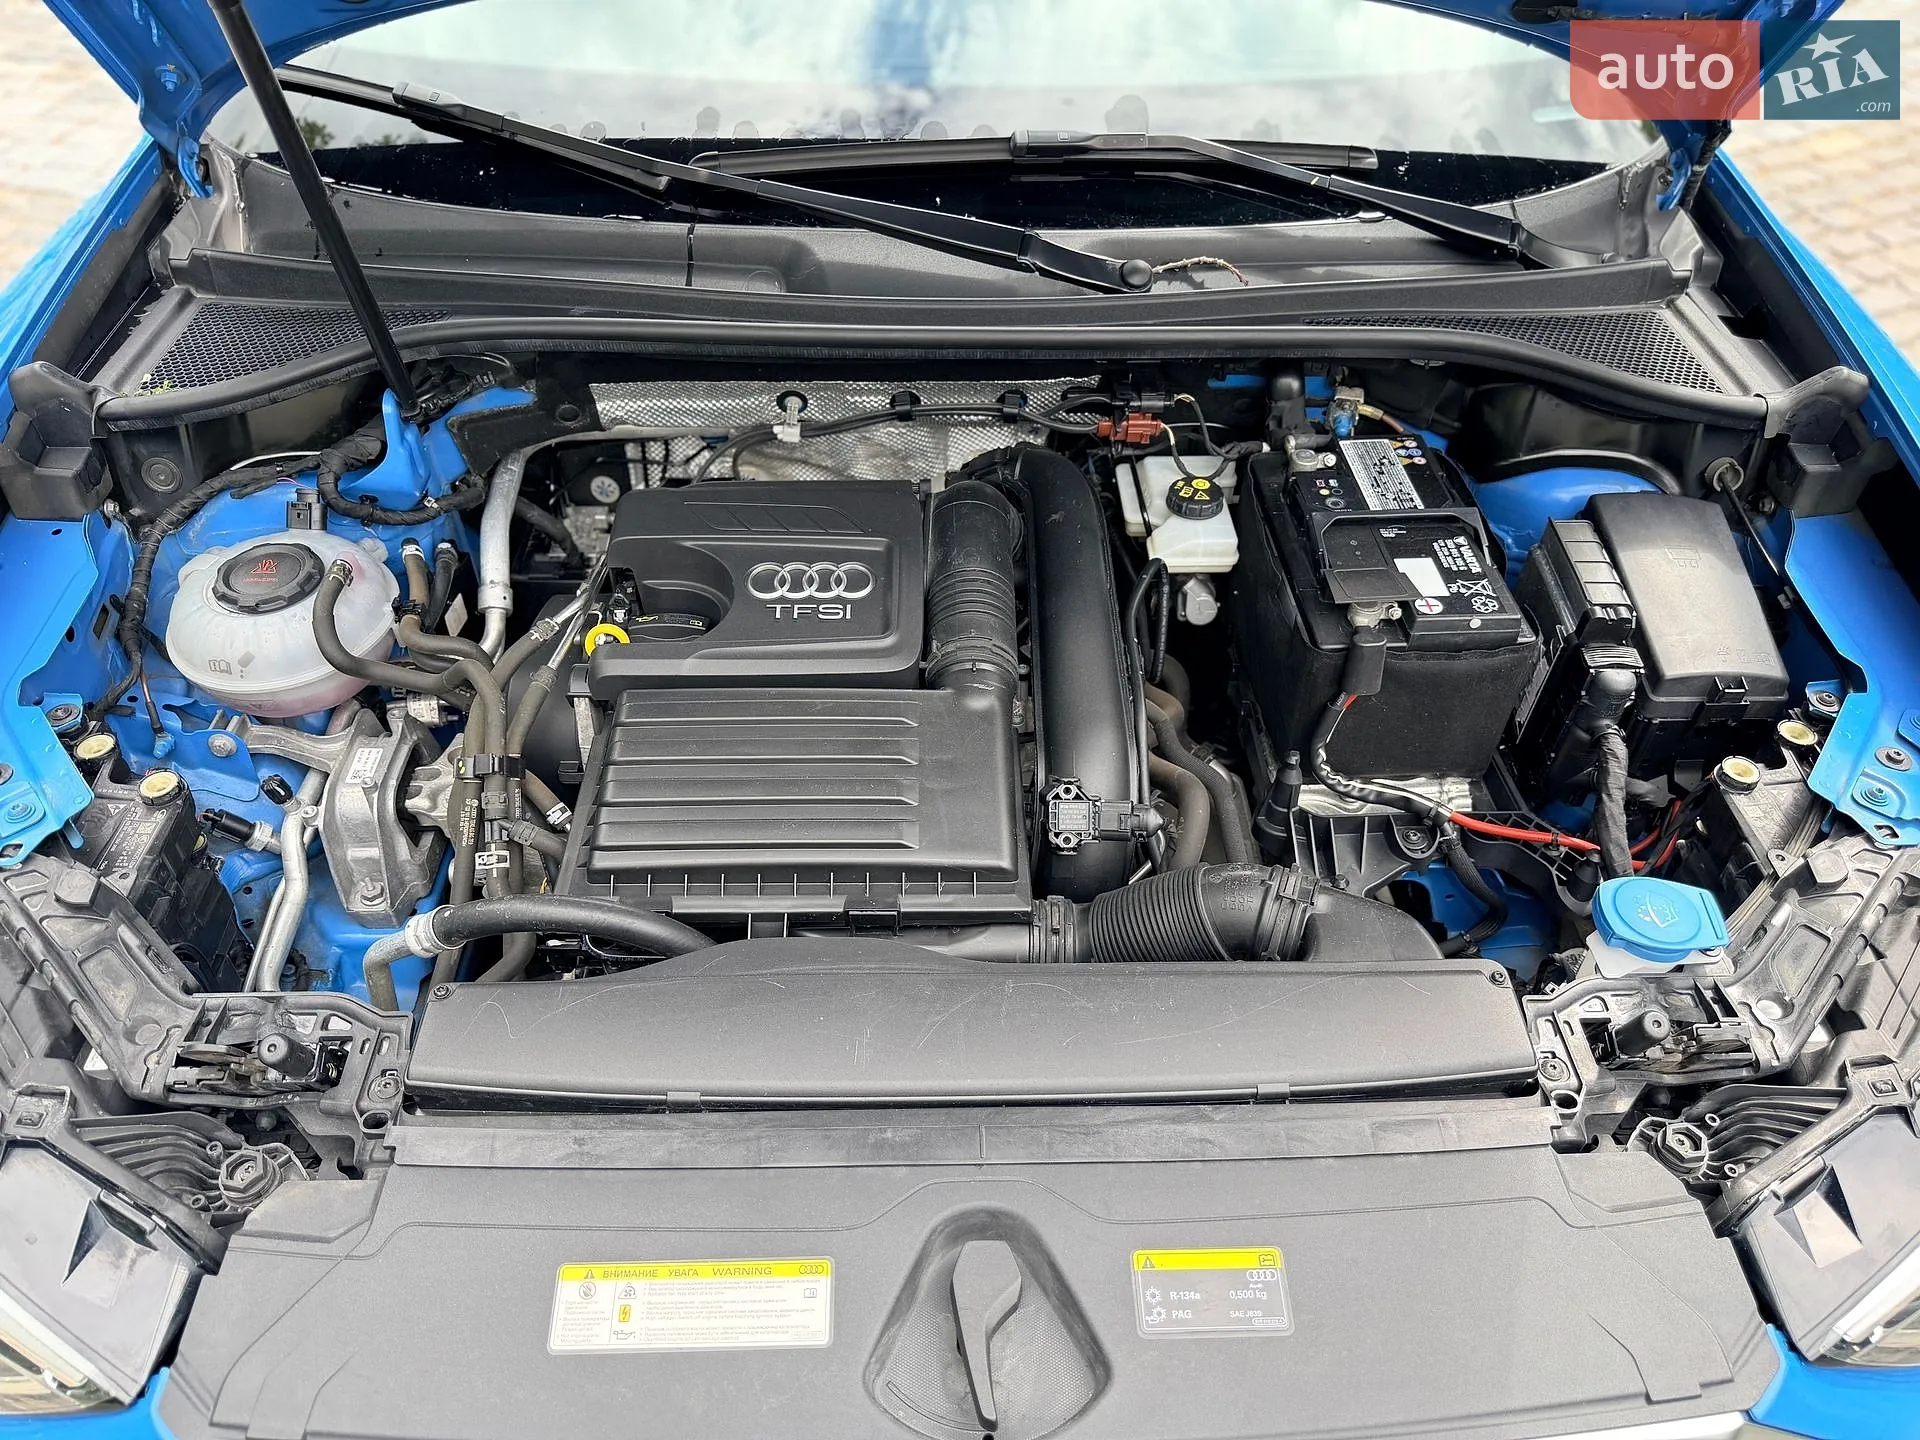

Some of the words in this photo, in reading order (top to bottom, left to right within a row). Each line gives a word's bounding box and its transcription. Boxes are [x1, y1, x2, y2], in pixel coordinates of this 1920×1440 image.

[1460, 545, 1482, 573] VARTA
[766, 603, 852, 620] TFSI
[602, 1269, 660, 1278] ВНИМАНИЕ
[667, 1268, 699, 1278] УВАГА
[712, 1267, 773, 1277] WARNING
[1169, 1291, 1201, 1301] R-134a
[1229, 1289, 1254, 1301] 0,500
[1255, 1288, 1268, 1300] kg
[1172, 1309, 1193, 1319] PAG
